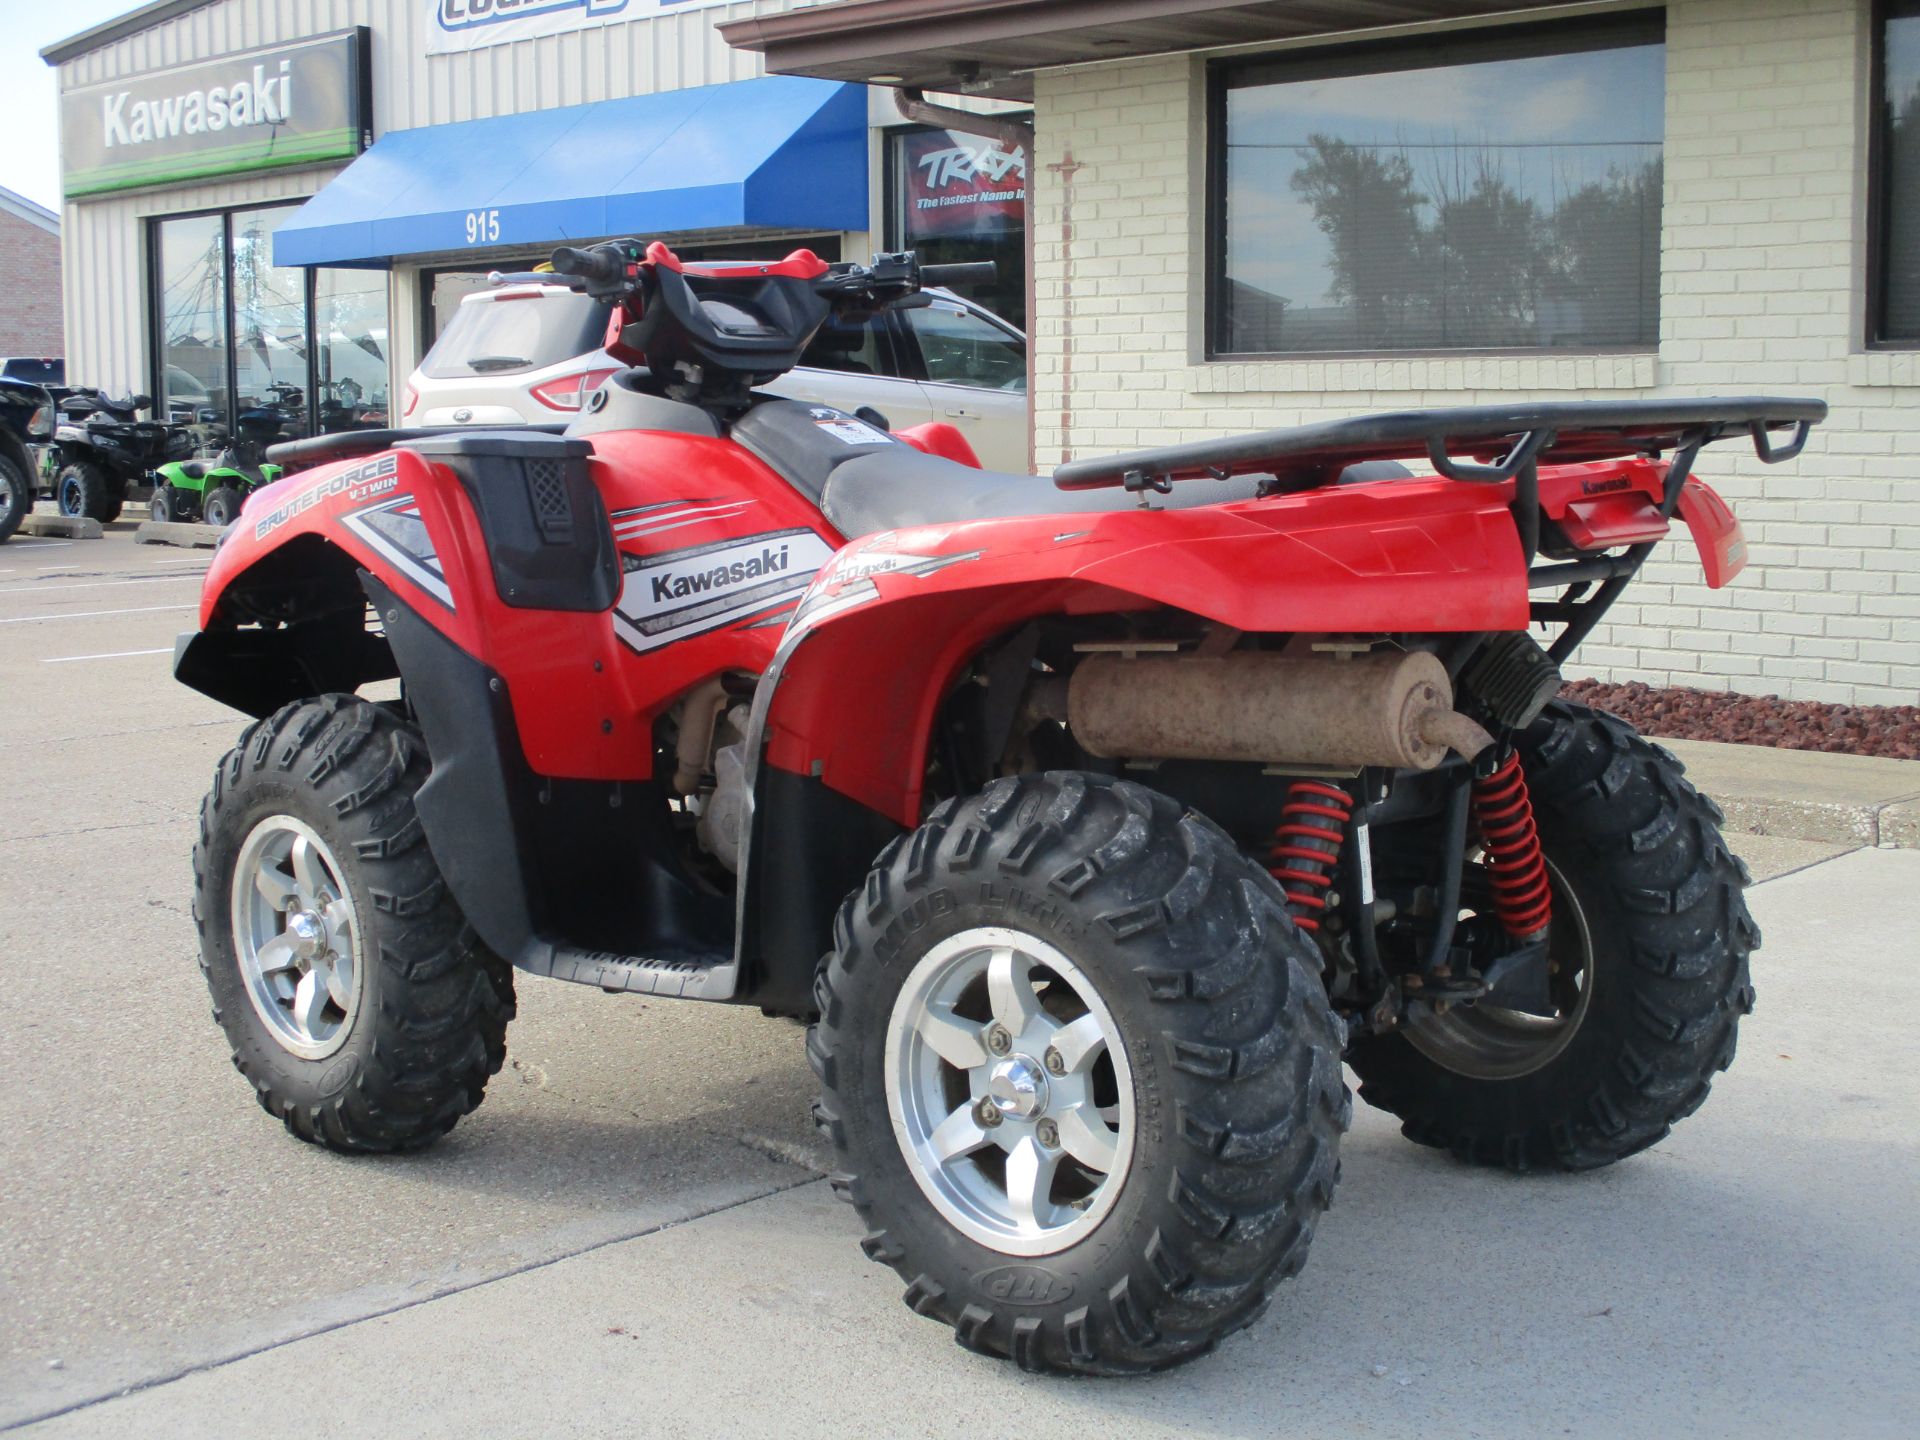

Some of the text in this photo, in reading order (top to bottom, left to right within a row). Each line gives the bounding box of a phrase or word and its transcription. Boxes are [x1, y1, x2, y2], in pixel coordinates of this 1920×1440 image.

[103, 60, 291, 147] Kawasaki
[917, 197, 938, 209] The
[939, 192, 977, 206] Fastest
[979, 190, 1014, 202] Name
[466, 210, 500, 244] 915
[256, 454, 397, 541] BRUTE FORCE
[350, 476, 398, 500] V-TWIN
[652, 544, 789, 603] Kawasaki
[992, 1273, 1055, 1301] ITP
